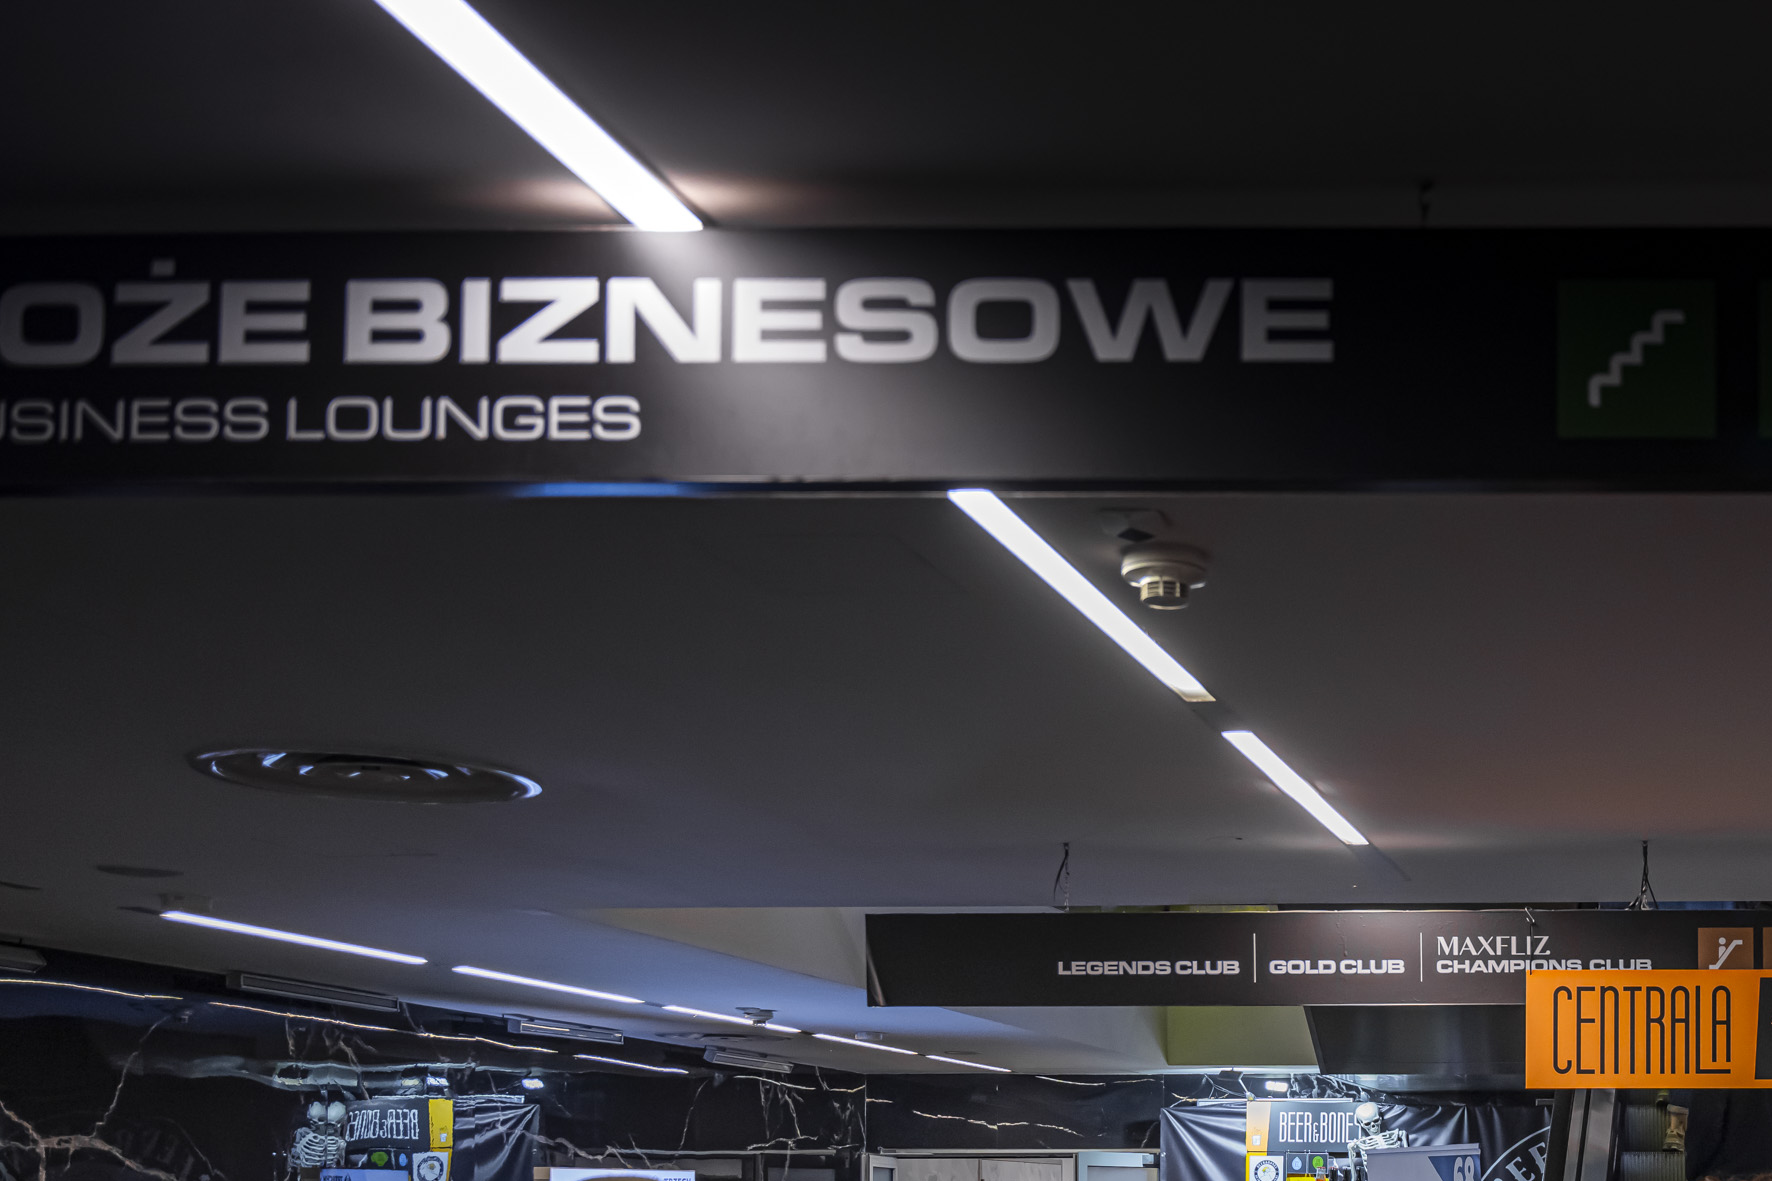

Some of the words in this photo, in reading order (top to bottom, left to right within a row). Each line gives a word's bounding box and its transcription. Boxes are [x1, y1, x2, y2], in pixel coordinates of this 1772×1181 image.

[344, 277, 1335, 364] BIZNESOWE
[0, 398, 270, 442] SINESS
[286, 396, 642, 442] LOUNGES
[1436, 935, 1552, 956] MAXFLIZ
[1057, 960, 1172, 976] LEGENDS
[1174, 960, 1241, 976] CLUB
[1268, 959, 1337, 975] GOLD
[1339, 959, 1406, 975] CLUB
[1436, 959, 1586, 974] CHAMPIONS
[1589, 958, 1653, 971] CLUB
[1552, 985, 1732, 1075] CENTRALA
